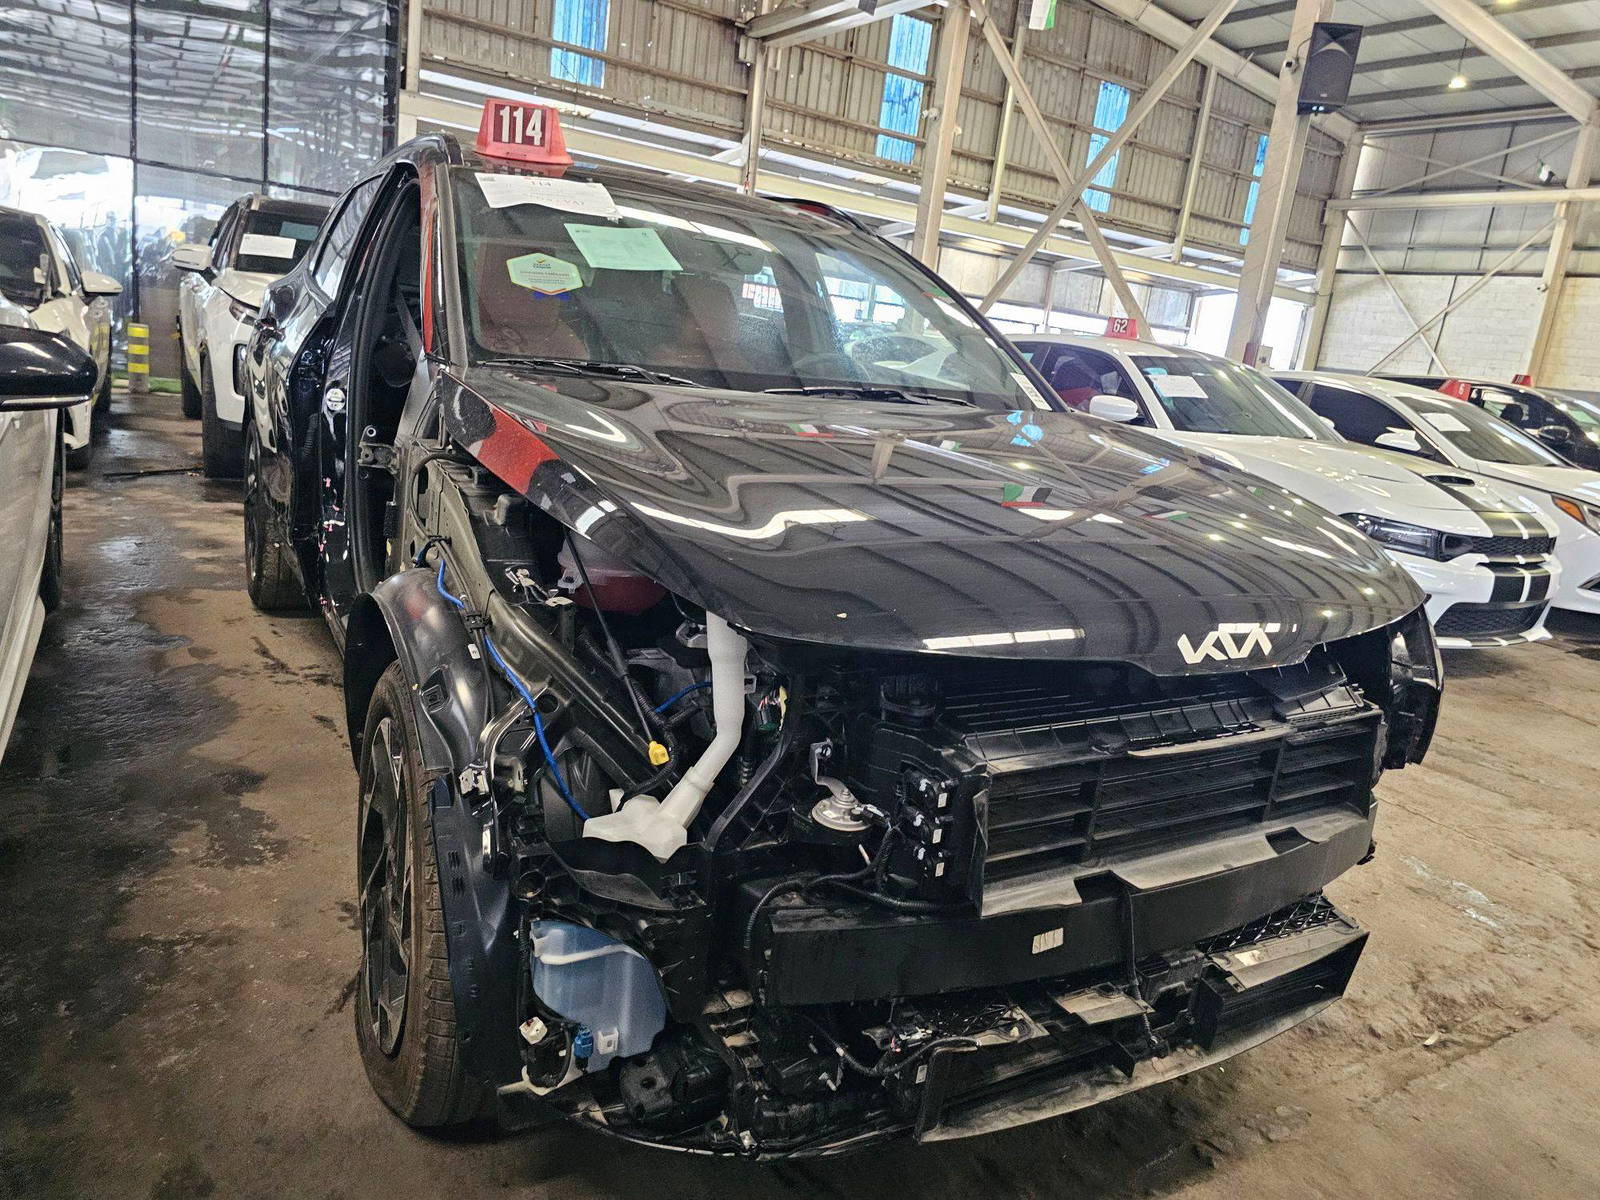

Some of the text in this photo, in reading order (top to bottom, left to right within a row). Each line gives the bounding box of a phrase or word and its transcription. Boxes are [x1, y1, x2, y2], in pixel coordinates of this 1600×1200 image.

[500, 105, 542, 146] 114
[1113, 319, 1128, 333] 62
[1177, 628, 1273, 664] KIA
